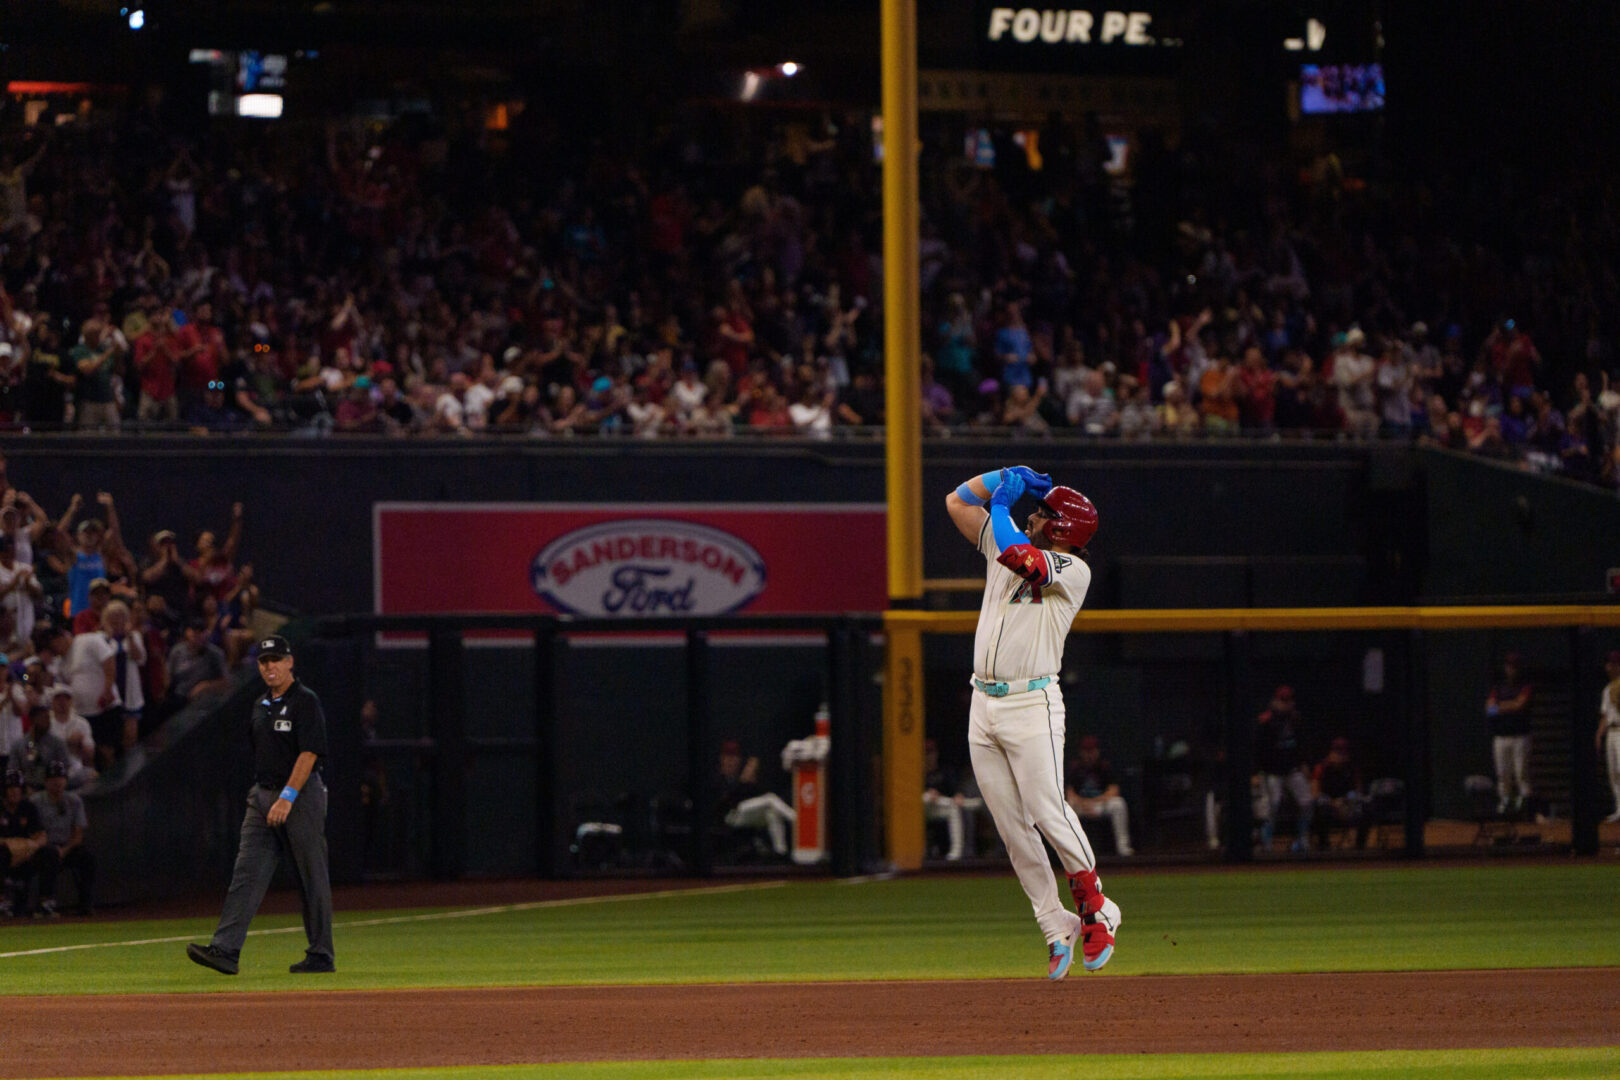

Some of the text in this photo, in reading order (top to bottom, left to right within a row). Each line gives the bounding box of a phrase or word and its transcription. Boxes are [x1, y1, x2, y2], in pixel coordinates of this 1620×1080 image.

[987, 7, 1095, 44] FOUR
[551, 537, 746, 586] SANDERSON
[603, 566, 698, 613] Ford
